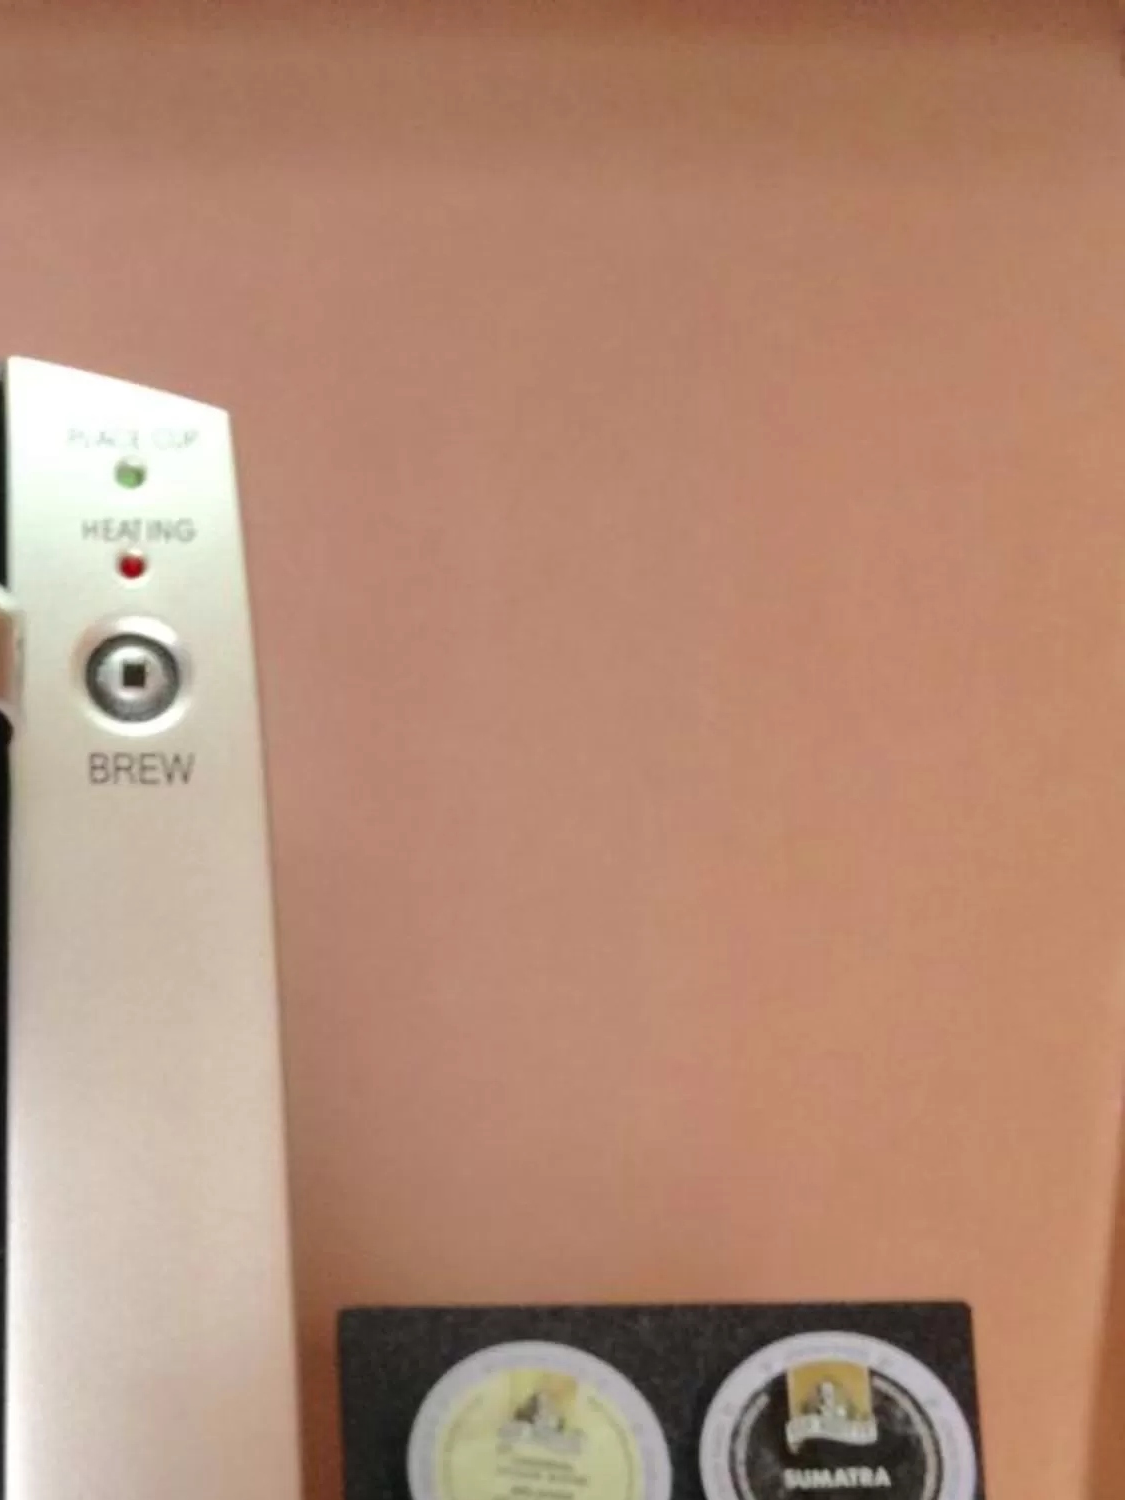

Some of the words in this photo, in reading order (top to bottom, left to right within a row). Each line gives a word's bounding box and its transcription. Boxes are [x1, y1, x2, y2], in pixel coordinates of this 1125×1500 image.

[151, 428, 200, 450] CUP
[81, 519, 197, 543] HEATING
[88, 753, 195, 785] BREW
[783, 1466, 892, 1490] SUMATRA
